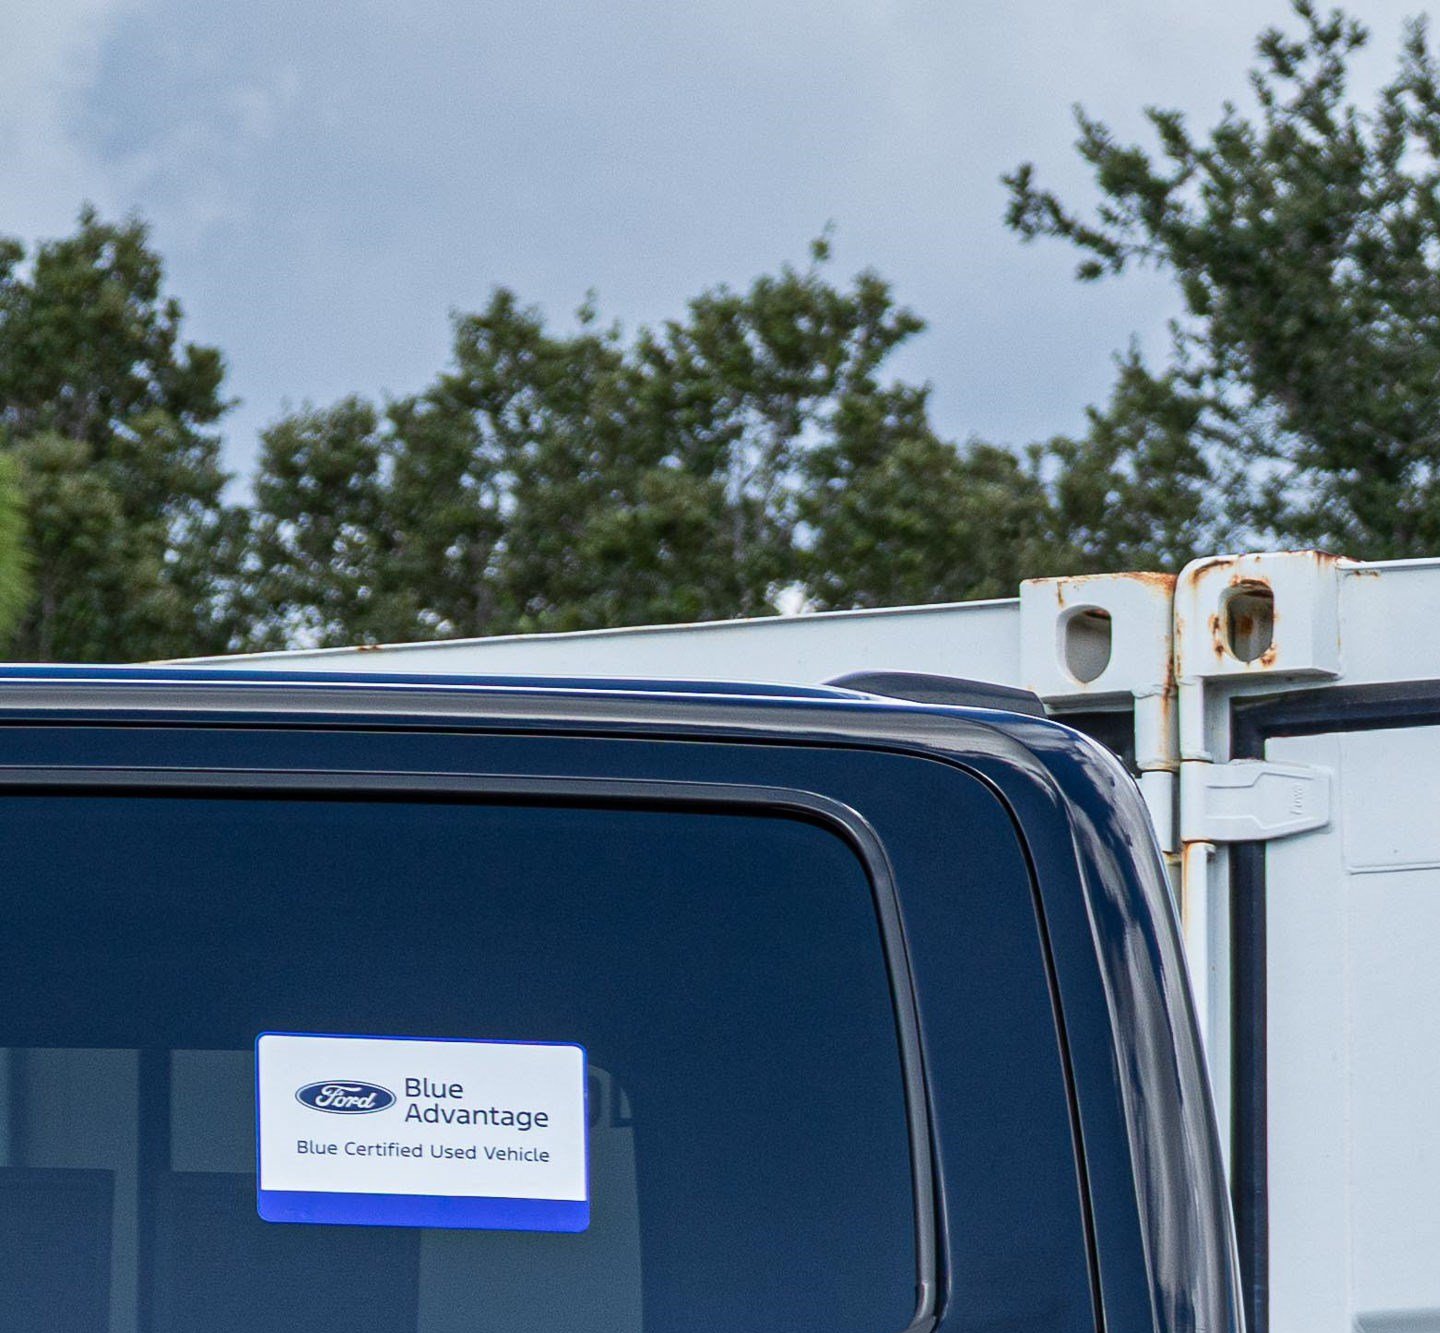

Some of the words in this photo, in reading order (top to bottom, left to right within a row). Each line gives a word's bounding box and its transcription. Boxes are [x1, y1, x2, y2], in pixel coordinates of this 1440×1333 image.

[404, 1078, 464, 1099] Blue
[404, 1103, 549, 1131] Advantage
[297, 1140, 338, 1155] Blue
[344, 1141, 423, 1159] Certified
[430, 1144, 477, 1161] Used
[484, 1146, 550, 1163] Vehicle
